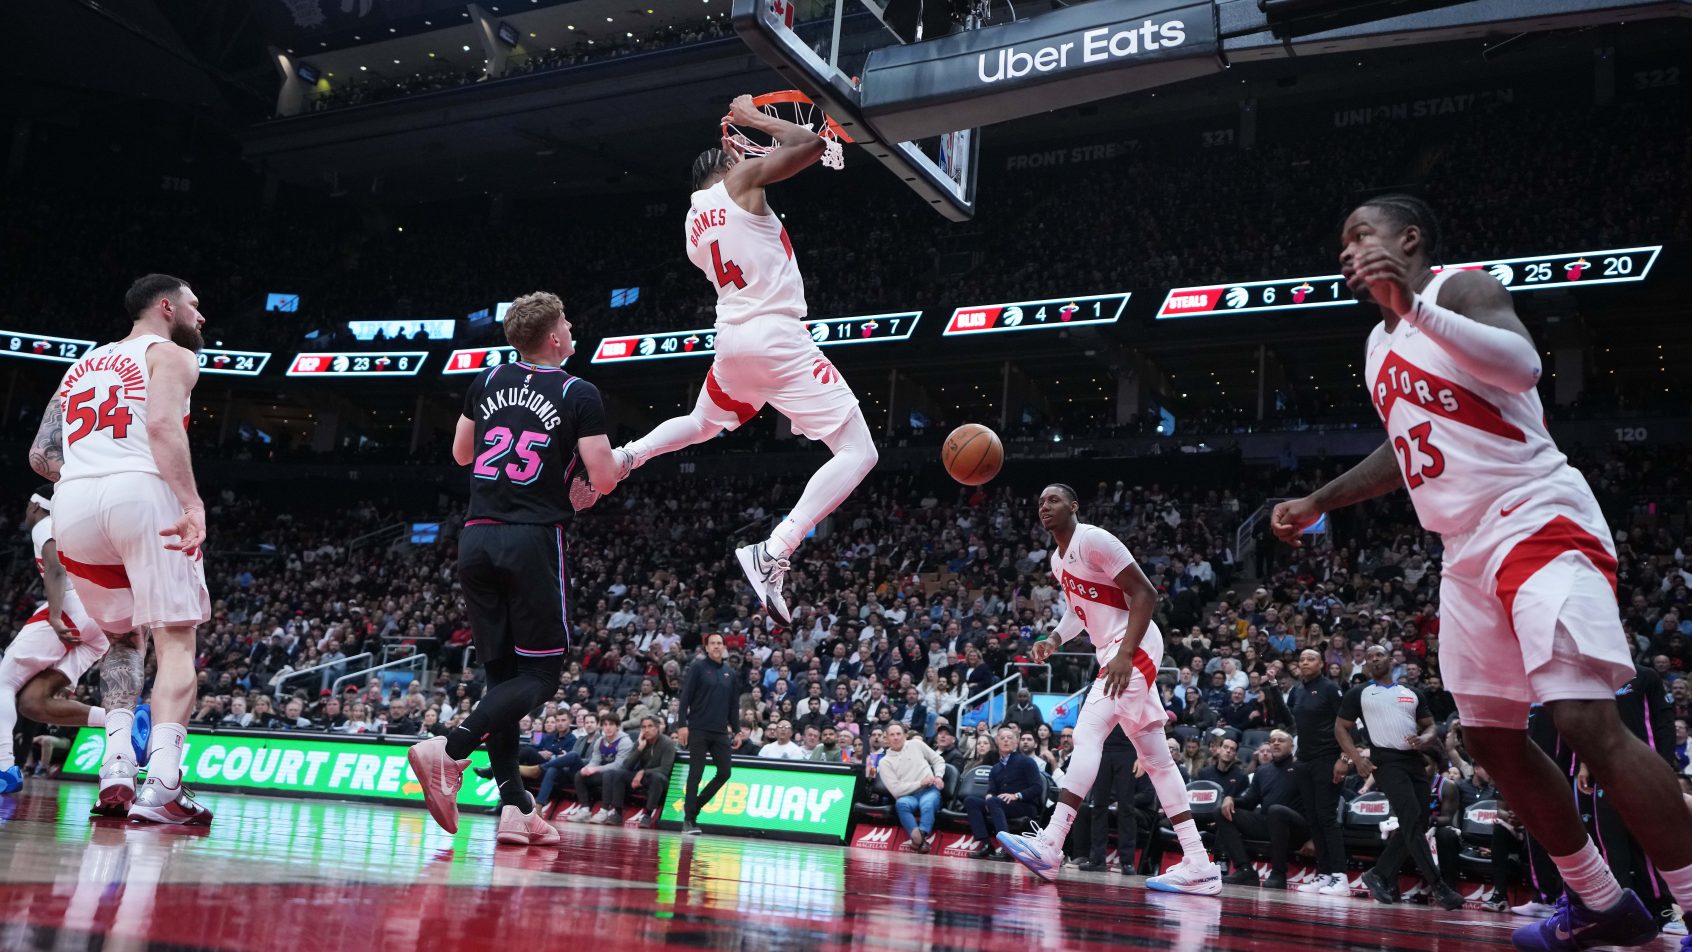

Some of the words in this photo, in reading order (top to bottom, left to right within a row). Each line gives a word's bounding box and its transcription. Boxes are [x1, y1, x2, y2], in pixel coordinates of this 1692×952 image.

[978, 41, 1073, 83] Uber
[1083, 19, 1186, 63] Eats
[1633, 67, 1680, 89] 322
[1201, 129, 1234, 148] 321
[1006, 150, 1068, 171] FRONT
[690, 208, 726, 248] BARNES
[710, 239, 748, 290] 4
[1524, 263, 1552, 282] 25
[1603, 256, 1632, 276] 20
[1168, 294, 1208, 309] STEALS
[1263, 287, 1276, 303] 6
[1330, 281, 1339, 298] 1
[957, 312, 987, 328] BLKS
[1035, 306, 1047, 322] 4
[1093, 301, 1101, 317] 1
[837, 323, 851, 338] 11
[889, 319, 901, 334] 7
[10, 337, 21, 351] 9
[59, 344, 76, 358] 12
[661, 337, 678, 352] 40
[704, 335, 715, 349] 3
[235, 356, 254, 370] 24
[353, 357, 370, 371] 23
[398, 356, 409, 371] 6
[508, 350, 518, 364] 9
[65, 384, 133, 447] 54
[480, 384, 562, 431] JAKUČIONIS
[1614, 427, 1648, 442] 120
[473, 425, 551, 486] 25
[1394, 421, 1445, 490] 23
[1074, 605, 1088, 628] 9
[196, 745, 336, 791] COURT
[1191, 790, 1214, 802] PRIME
[1359, 802, 1385, 813] PRIME
